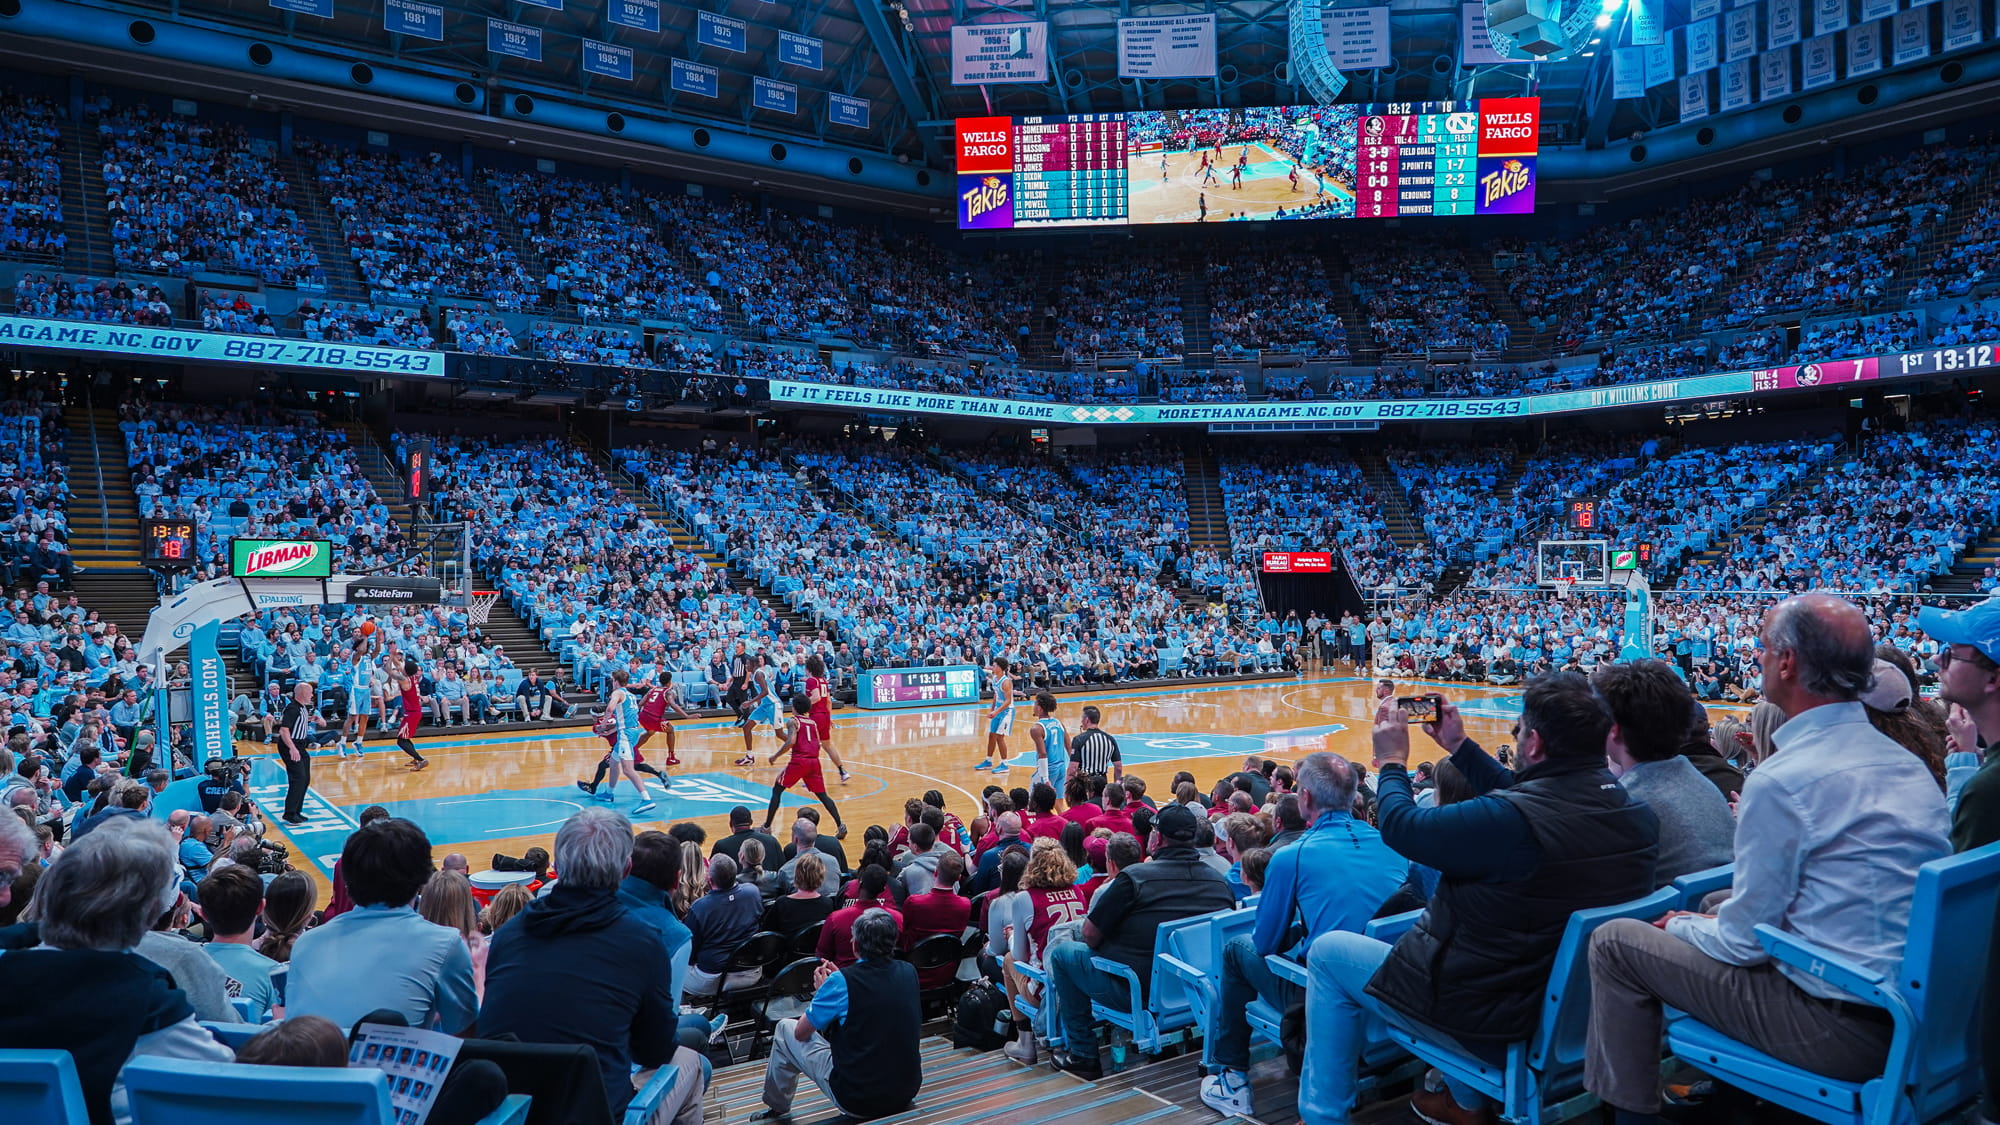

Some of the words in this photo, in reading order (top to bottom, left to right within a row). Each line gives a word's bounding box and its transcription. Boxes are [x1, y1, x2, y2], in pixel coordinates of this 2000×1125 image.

[402, 2, 442, 16] CHAMPIONS
[624, 4, 644, 17] 1972
[403, 11, 426, 25] 1981
[701, 12, 713, 22] ACC
[713, 16, 744, 30] CHAMPIONS
[489, 20, 503, 30] ACC
[504, 22, 540, 38] CHAMPIONS
[714, 25, 732, 38] 1975
[504, 32, 527, 46] 1982
[781, 34, 792, 44] ACC
[792, 36, 822, 48] CHAMPIONS
[585, 40, 597, 50] ACC
[598, 44, 632, 58] CHAMPIONS
[598, 53, 619, 66] 1983
[965, 54, 995, 62] NATIONAL
[673, 61, 685, 70] ACC
[686, 64, 716, 76] CHAMPIONS
[990, 62, 999, 70] 32
[686, 72, 705, 85] 1984
[1008, 70, 1036, 78] McGUIRE
[842, 97, 868, 108] CHAMPIONS
[1388, 103, 1411, 114] 13:12
[1442, 102, 1452, 112] 18
[1427, 116, 1436, 134] 5
[1485, 113, 1532, 125] WELLS
[1022, 124, 1059, 134] SOMERVILLE
[1401, 116, 1409, 135] 7
[962, 131, 1007, 144] WELLS
[1023, 134, 1041, 143] MILES
[1486, 127, 1532, 139] FARGO
[964, 144, 1007, 156] FARGO
[1369, 147, 1389, 158] 3-9
[1400, 148, 1414, 156] FIELD
[1414, 147, 1435, 155] GOALS
[1445, 144, 1467, 156] 1-11
[1024, 153, 1044, 162] MAGEE
[1024, 162, 1043, 172] JONES
[1370, 162, 1388, 173] 1-6
[1407, 162, 1424, 170] POINT
[1447, 160, 1464, 170] 1-7
[1368, 176, 1388, 188] 0-0
[1399, 177, 1411, 185] FREE
[1445, 174, 1465, 185] 2-2
[1451, 188, 1458, 199] 8
[1481, 168, 1529, 208] Takis
[1025, 190, 1047, 200] WILSON
[1374, 191, 1382, 202] 8
[1402, 191, 1431, 199] REBOUNDS
[964, 184, 1008, 223] Takis
[1025, 200, 1047, 209] POWELL
[1400, 205, 1432, 213] TURNOVERS
[1451, 203, 1456, 213] 1
[1373, 205, 1381, 216] 3
[0, 322, 202, 352] AGAME.NC.GOV
[224, 340, 432, 372] 887-718-5543
[1900, 353, 1924, 374] 1ST
[1932, 345, 1991, 370] 13:12
[1754, 372, 1770, 381] TOL:
[1772, 370, 1778, 379] 4
[1853, 359, 1864, 380] 7
[1754, 380, 1771, 390] FLS:
[1772, 379, 1778, 388] 2
[1590, 390, 1607, 406] ROY
[1609, 386, 1650, 404] WILLIAMS
[1652, 382, 1678, 400] COURT
[780, 386, 798, 397] IF
[802, 388, 820, 398] IT
[824, 389, 872, 404] FEELS
[877, 394, 910, 406] LIKE
[916, 397, 955, 410] MORE
[961, 400, 998, 413] THAN
[1002, 404, 1013, 414] A
[1017, 406, 1054, 418] GAME
[1157, 406, 1364, 419] MORETHANAGAME.NC.GOV
[1377, 401, 1520, 417] 887-718-5543
[1580, 512, 1591, 528] 18
[153, 525, 191, 538] 13:12
[164, 540, 181, 558] 18
[246, 544, 312, 574] LIBMAN
[259, 594, 303, 604] SPALDING
[890, 674, 897, 686] 7
[920, 672, 940, 684] 13:12
[649, 692, 659, 702] 3
[201, 658, 222, 760] GOHEELS.COM
[806, 725, 812, 742] 1
[206, 786, 230, 795] CREW
[1046, 889, 1078, 902] STEEN
[1810, 959, 1826, 977] H
